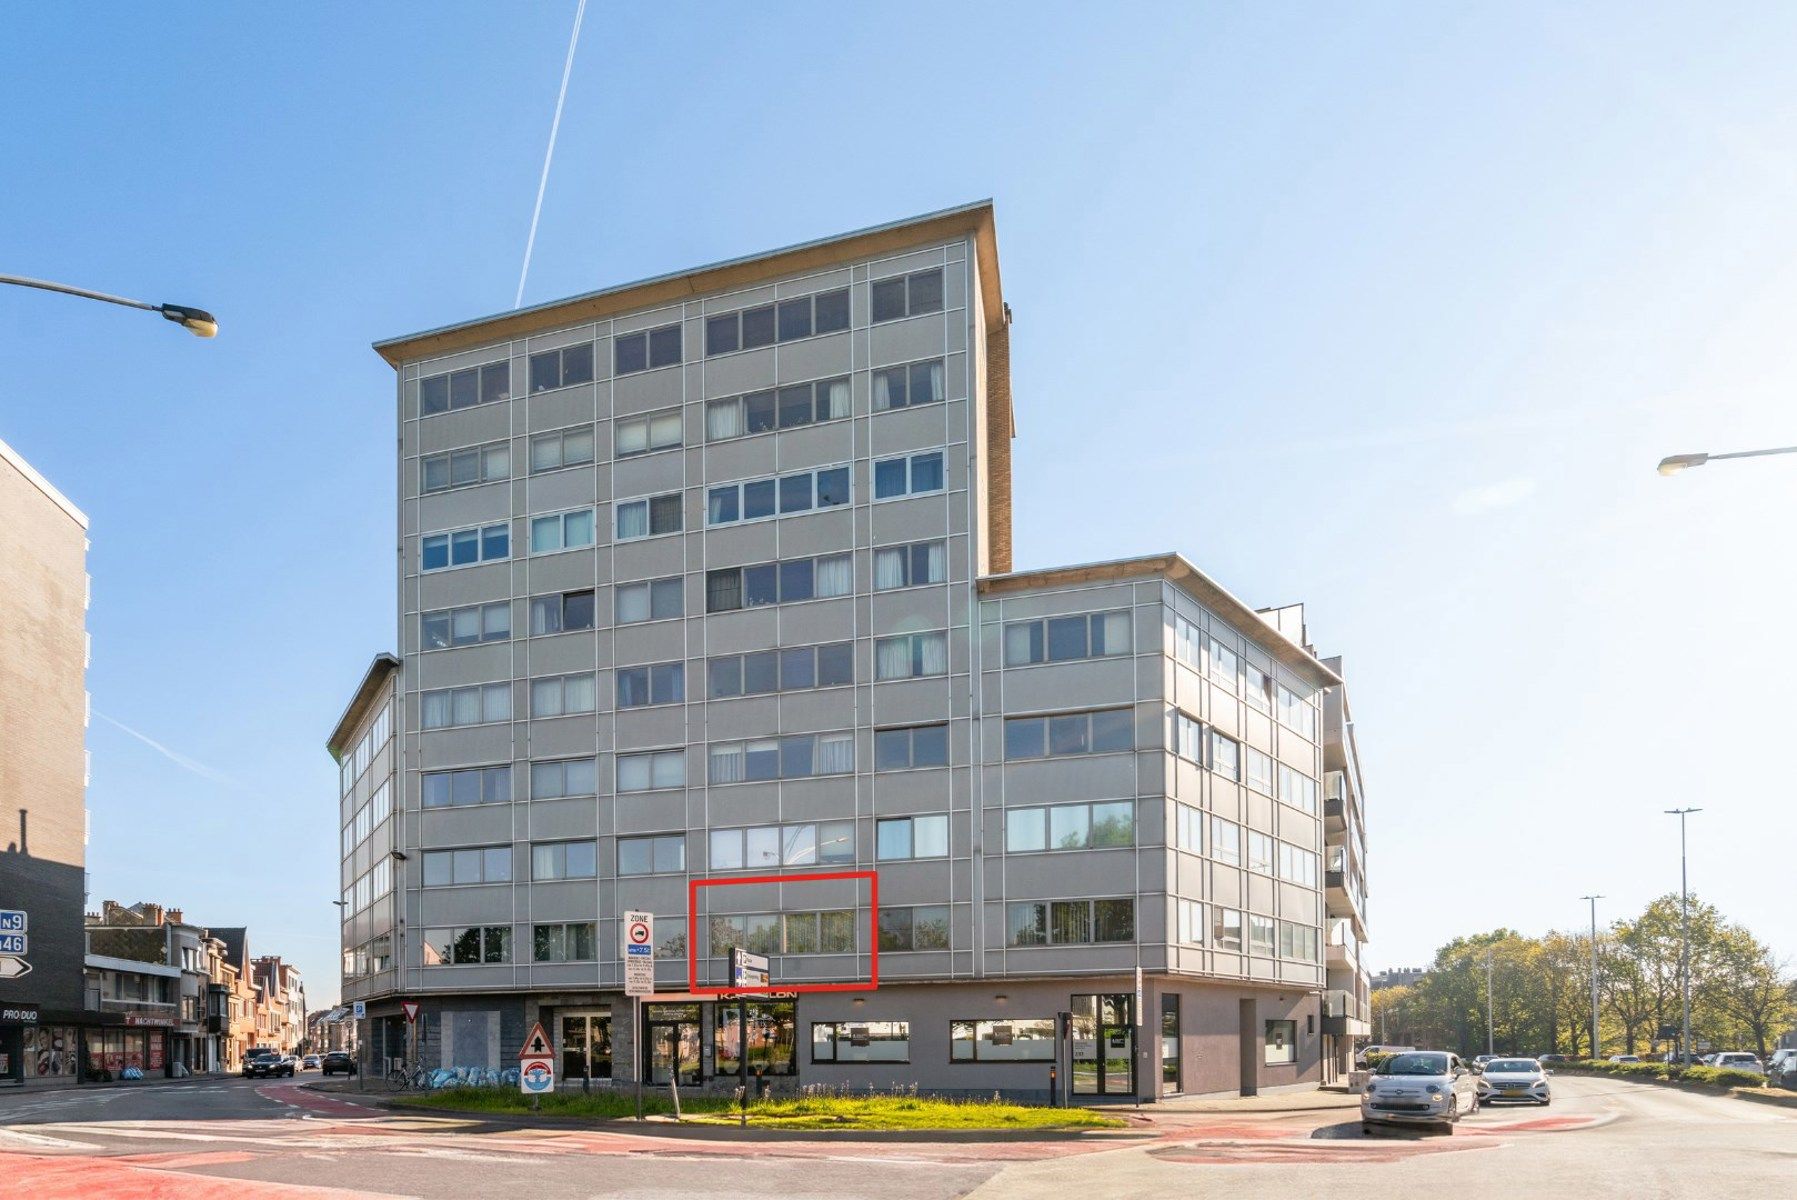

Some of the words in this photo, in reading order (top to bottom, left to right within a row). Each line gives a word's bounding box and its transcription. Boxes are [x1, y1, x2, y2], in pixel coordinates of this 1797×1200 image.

[2, 915, 22, 930] N9
[630, 914, 648, 923] ZONE
[0, 936, 22, 951] 46
[2, 1009, 20, 1020] PRO
[20, 1010, 38, 1020] DUO
